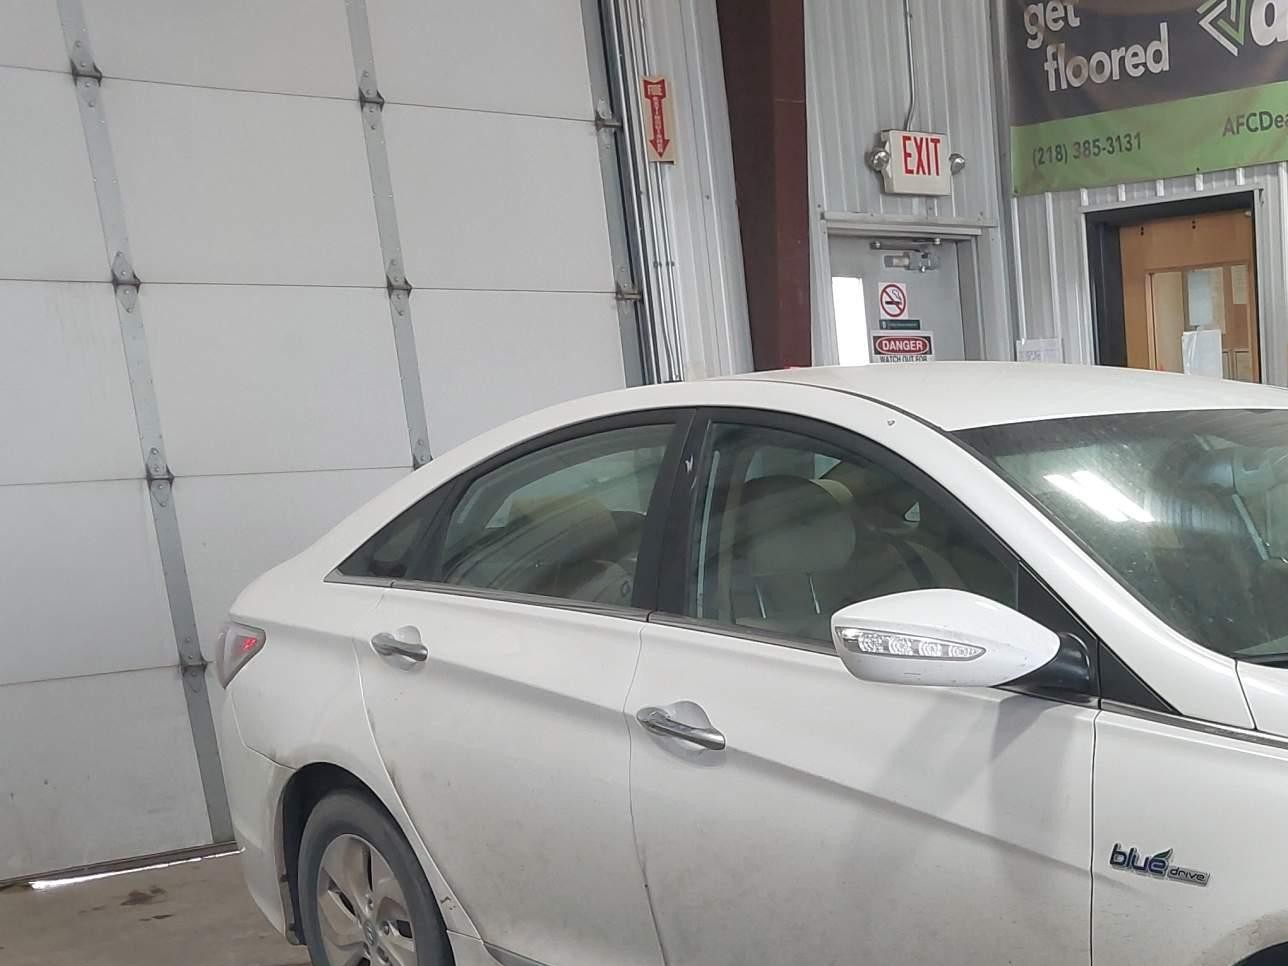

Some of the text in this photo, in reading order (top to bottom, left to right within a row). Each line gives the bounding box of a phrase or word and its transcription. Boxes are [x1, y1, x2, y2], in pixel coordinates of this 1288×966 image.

[1024, 0, 1080, 49] get
[1044, 22, 1169, 91] floored
[902, 135, 941, 176] EXIT
[1032, 132, 1143, 168] (218) 385-3131
[882, 341, 923, 350] DANGER
[1109, 843, 1205, 881] blue drive
